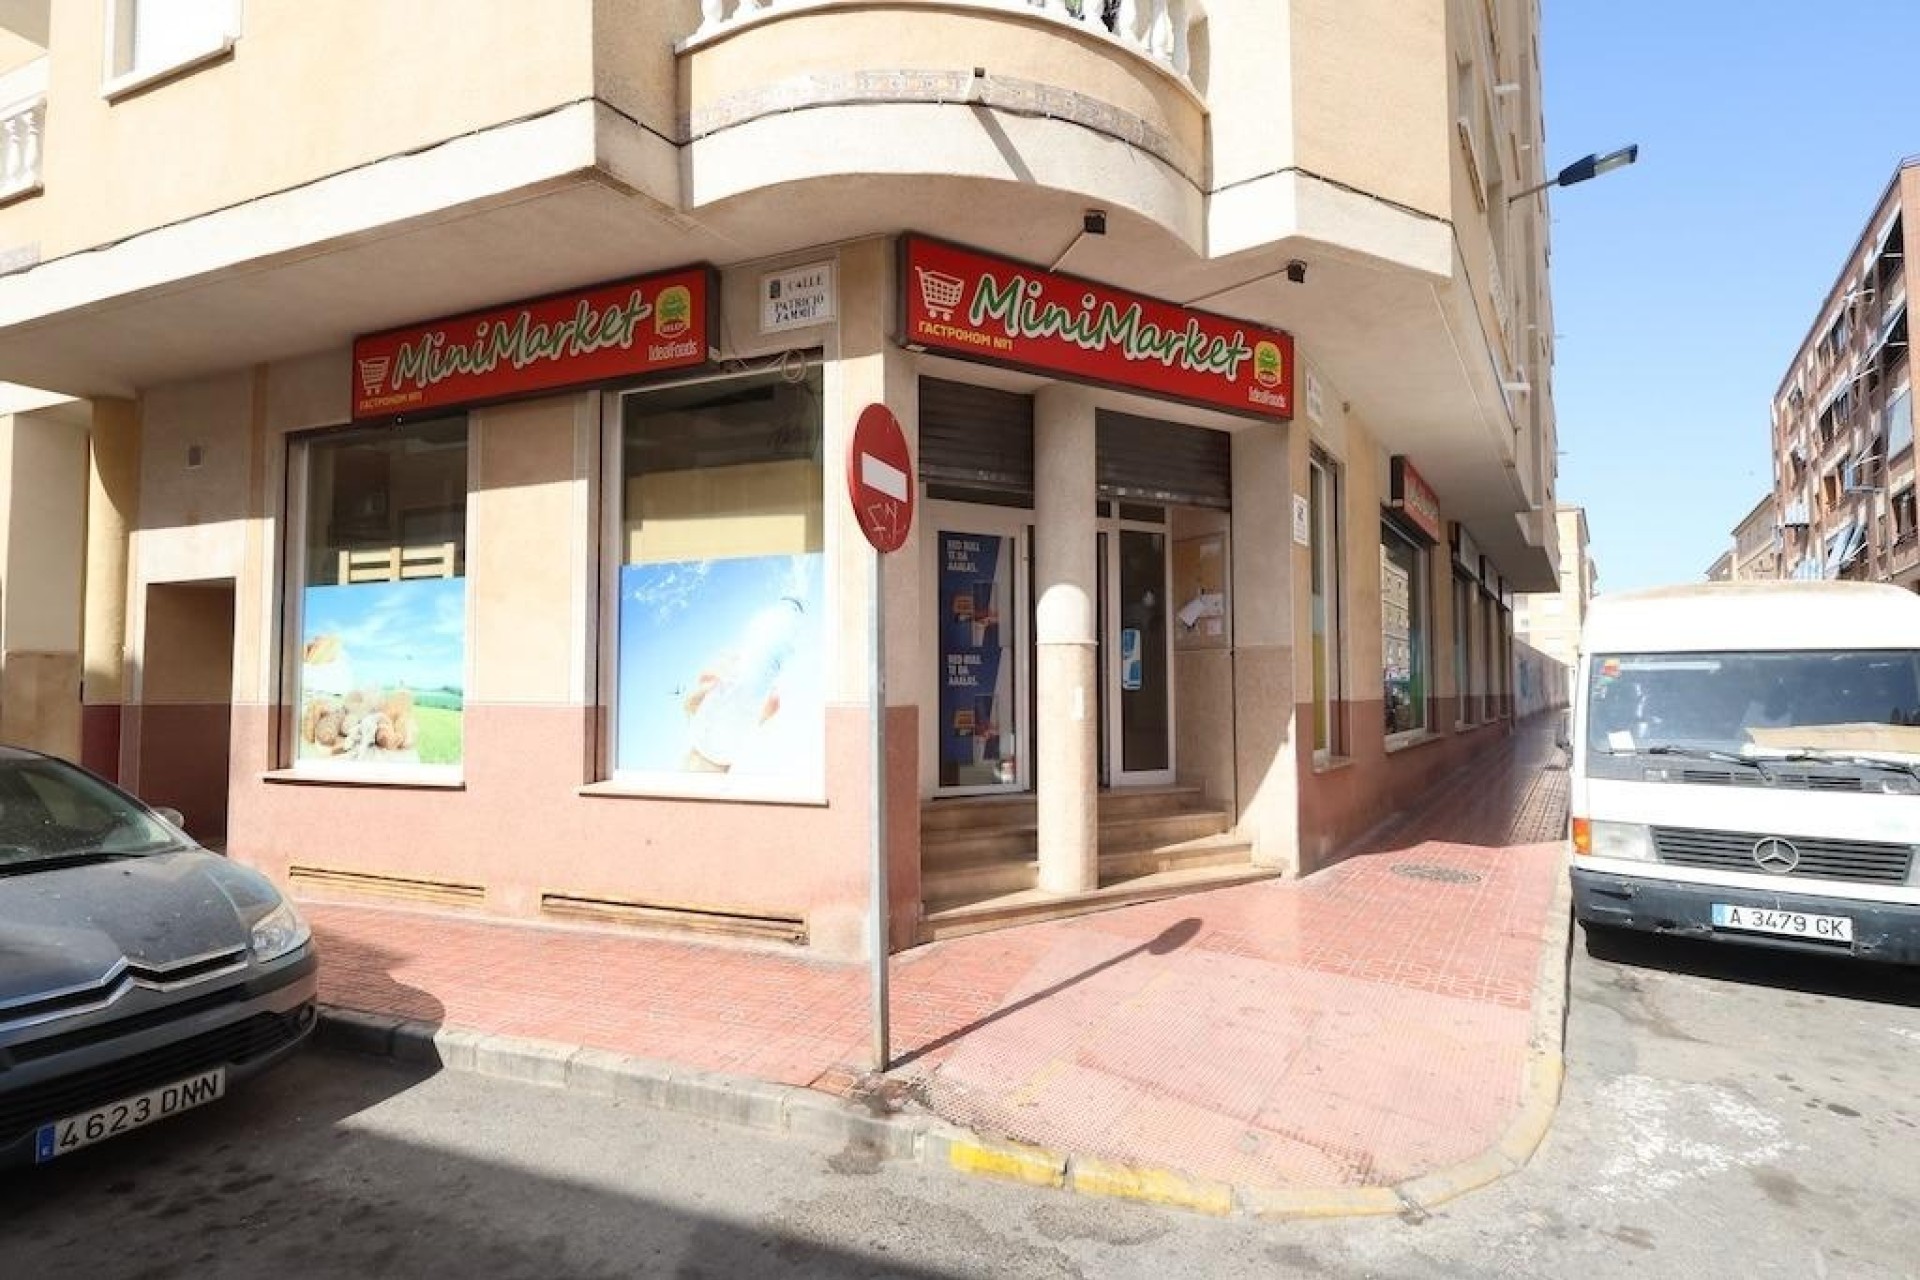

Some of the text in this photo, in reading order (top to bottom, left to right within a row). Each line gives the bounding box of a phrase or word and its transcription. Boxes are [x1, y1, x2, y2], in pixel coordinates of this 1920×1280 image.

[786, 273, 824, 291] CALLE
[392, 289, 652, 390] MiniMarket
[919, 320, 991, 346] ГАСТРОНОМ
[969, 273, 1253, 381] MiniMarket
[1730, 908, 1844, 938] A 3479 GK
[59, 1073, 218, 1147] 4623 DNN
